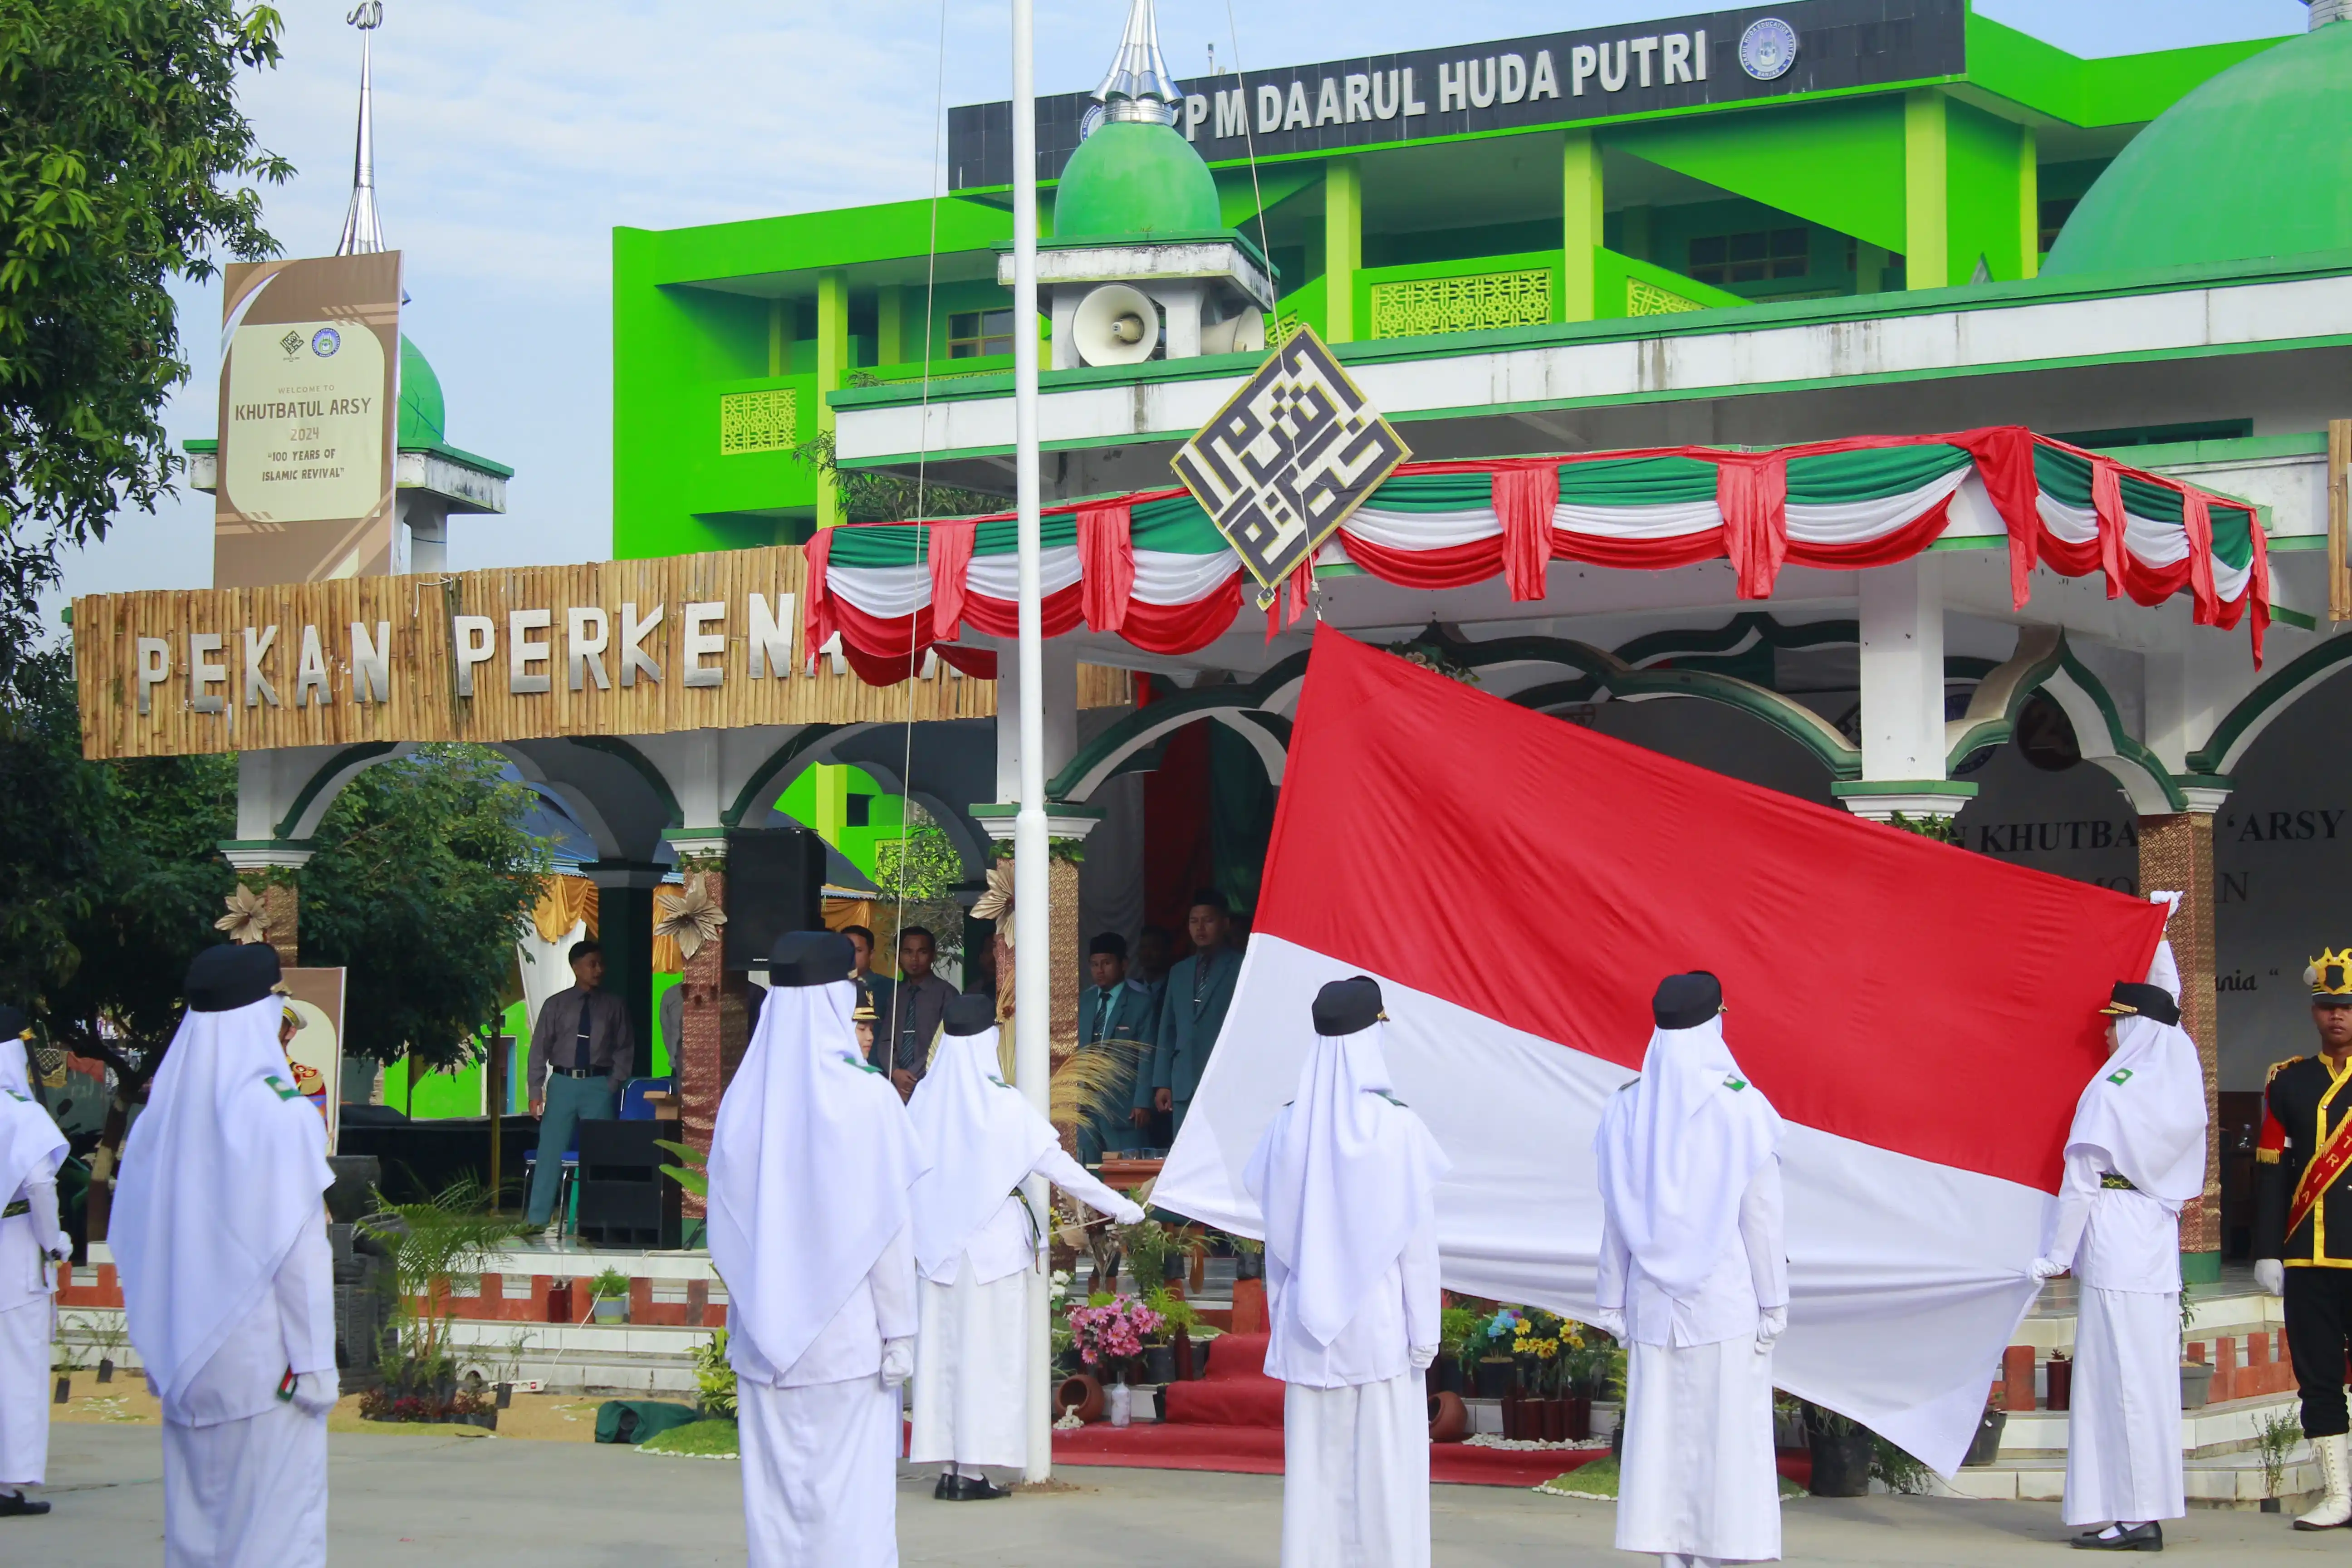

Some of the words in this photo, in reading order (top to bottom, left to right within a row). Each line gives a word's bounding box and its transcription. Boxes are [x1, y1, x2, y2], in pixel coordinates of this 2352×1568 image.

[1743, 27, 1758, 43] HUDA
[1757, 21, 1789, 35] EDUCATION
[1742, 45, 1750, 66] DARUL
[1757, 69, 1779, 77] BANJAR
[1173, 89, 1246, 142] PM
[1258, 67, 1426, 135] DAARUL
[1439, 50, 1560, 113] HUDA
[1572, 30, 1707, 97] PUTRI
[278, 386, 320, 394] WELCOME
[235, 401, 324, 421] KHUTBATUL
[329, 397, 372, 415] ARSY
[290, 427, 319, 441] 2024
[292, 450, 320, 461] YEARS
[324, 449, 336, 459] OF
[262, 470, 298, 482] ISLAMIC
[138, 622, 391, 714] PEKAN
[454, 593, 964, 696] PERKEN
[1979, 819, 2215, 853] KHUTBA
